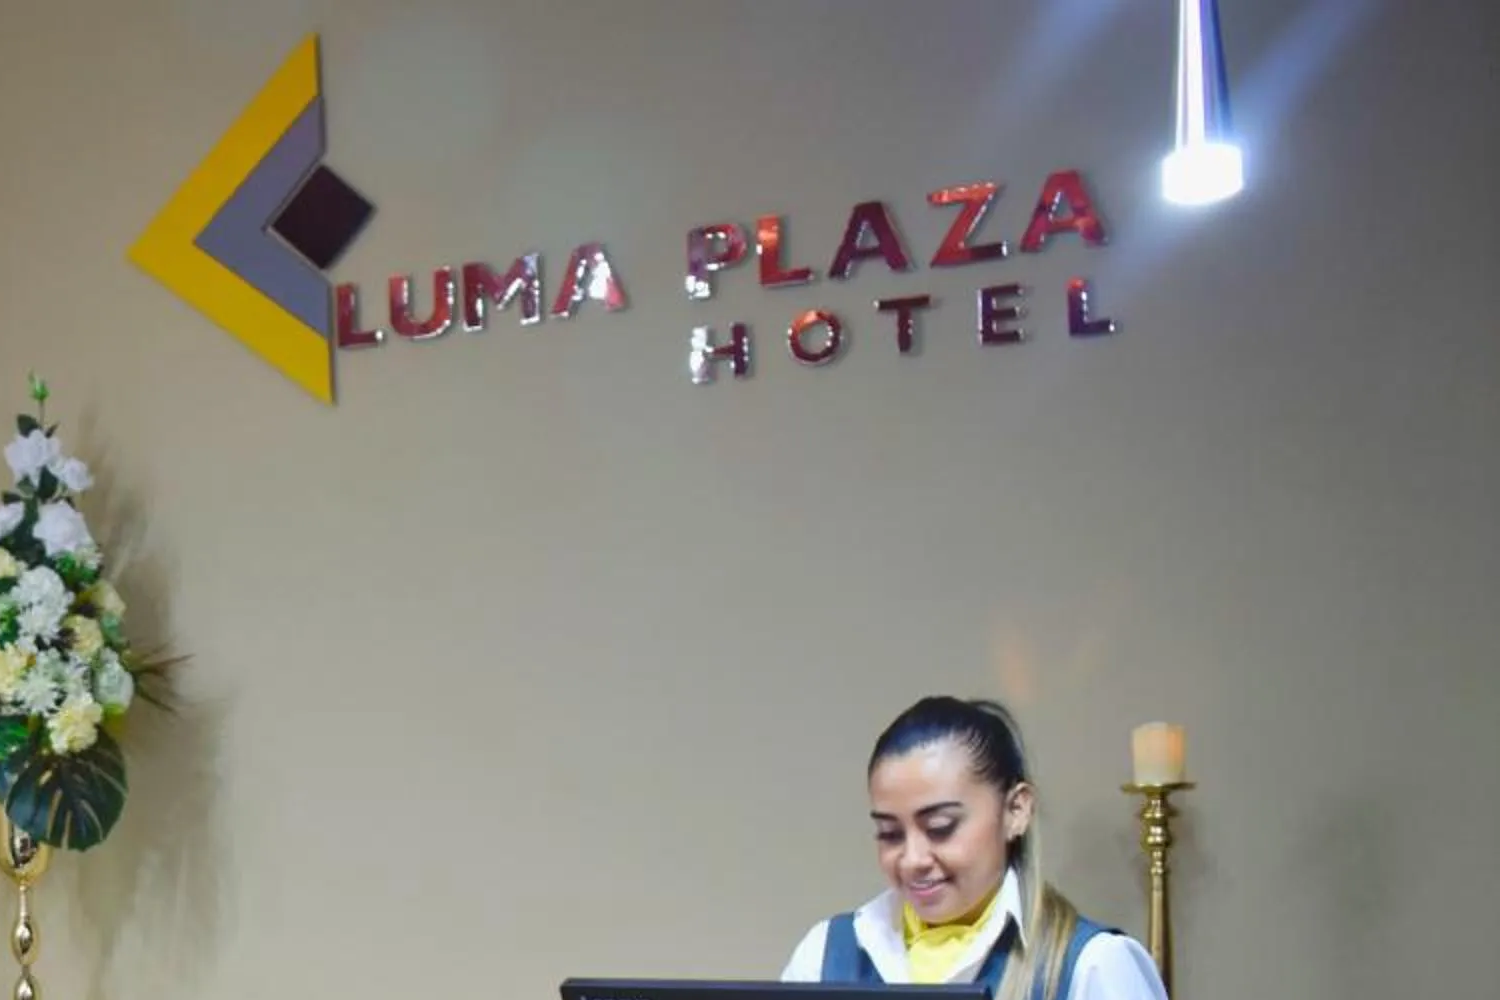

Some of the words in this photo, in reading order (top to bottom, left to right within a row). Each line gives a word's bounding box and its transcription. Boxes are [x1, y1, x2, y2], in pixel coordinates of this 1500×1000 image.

[336, 242, 626, 348] LUMA
[685, 168, 1108, 298] PLAZA
[689, 276, 1116, 385] HOTEL
